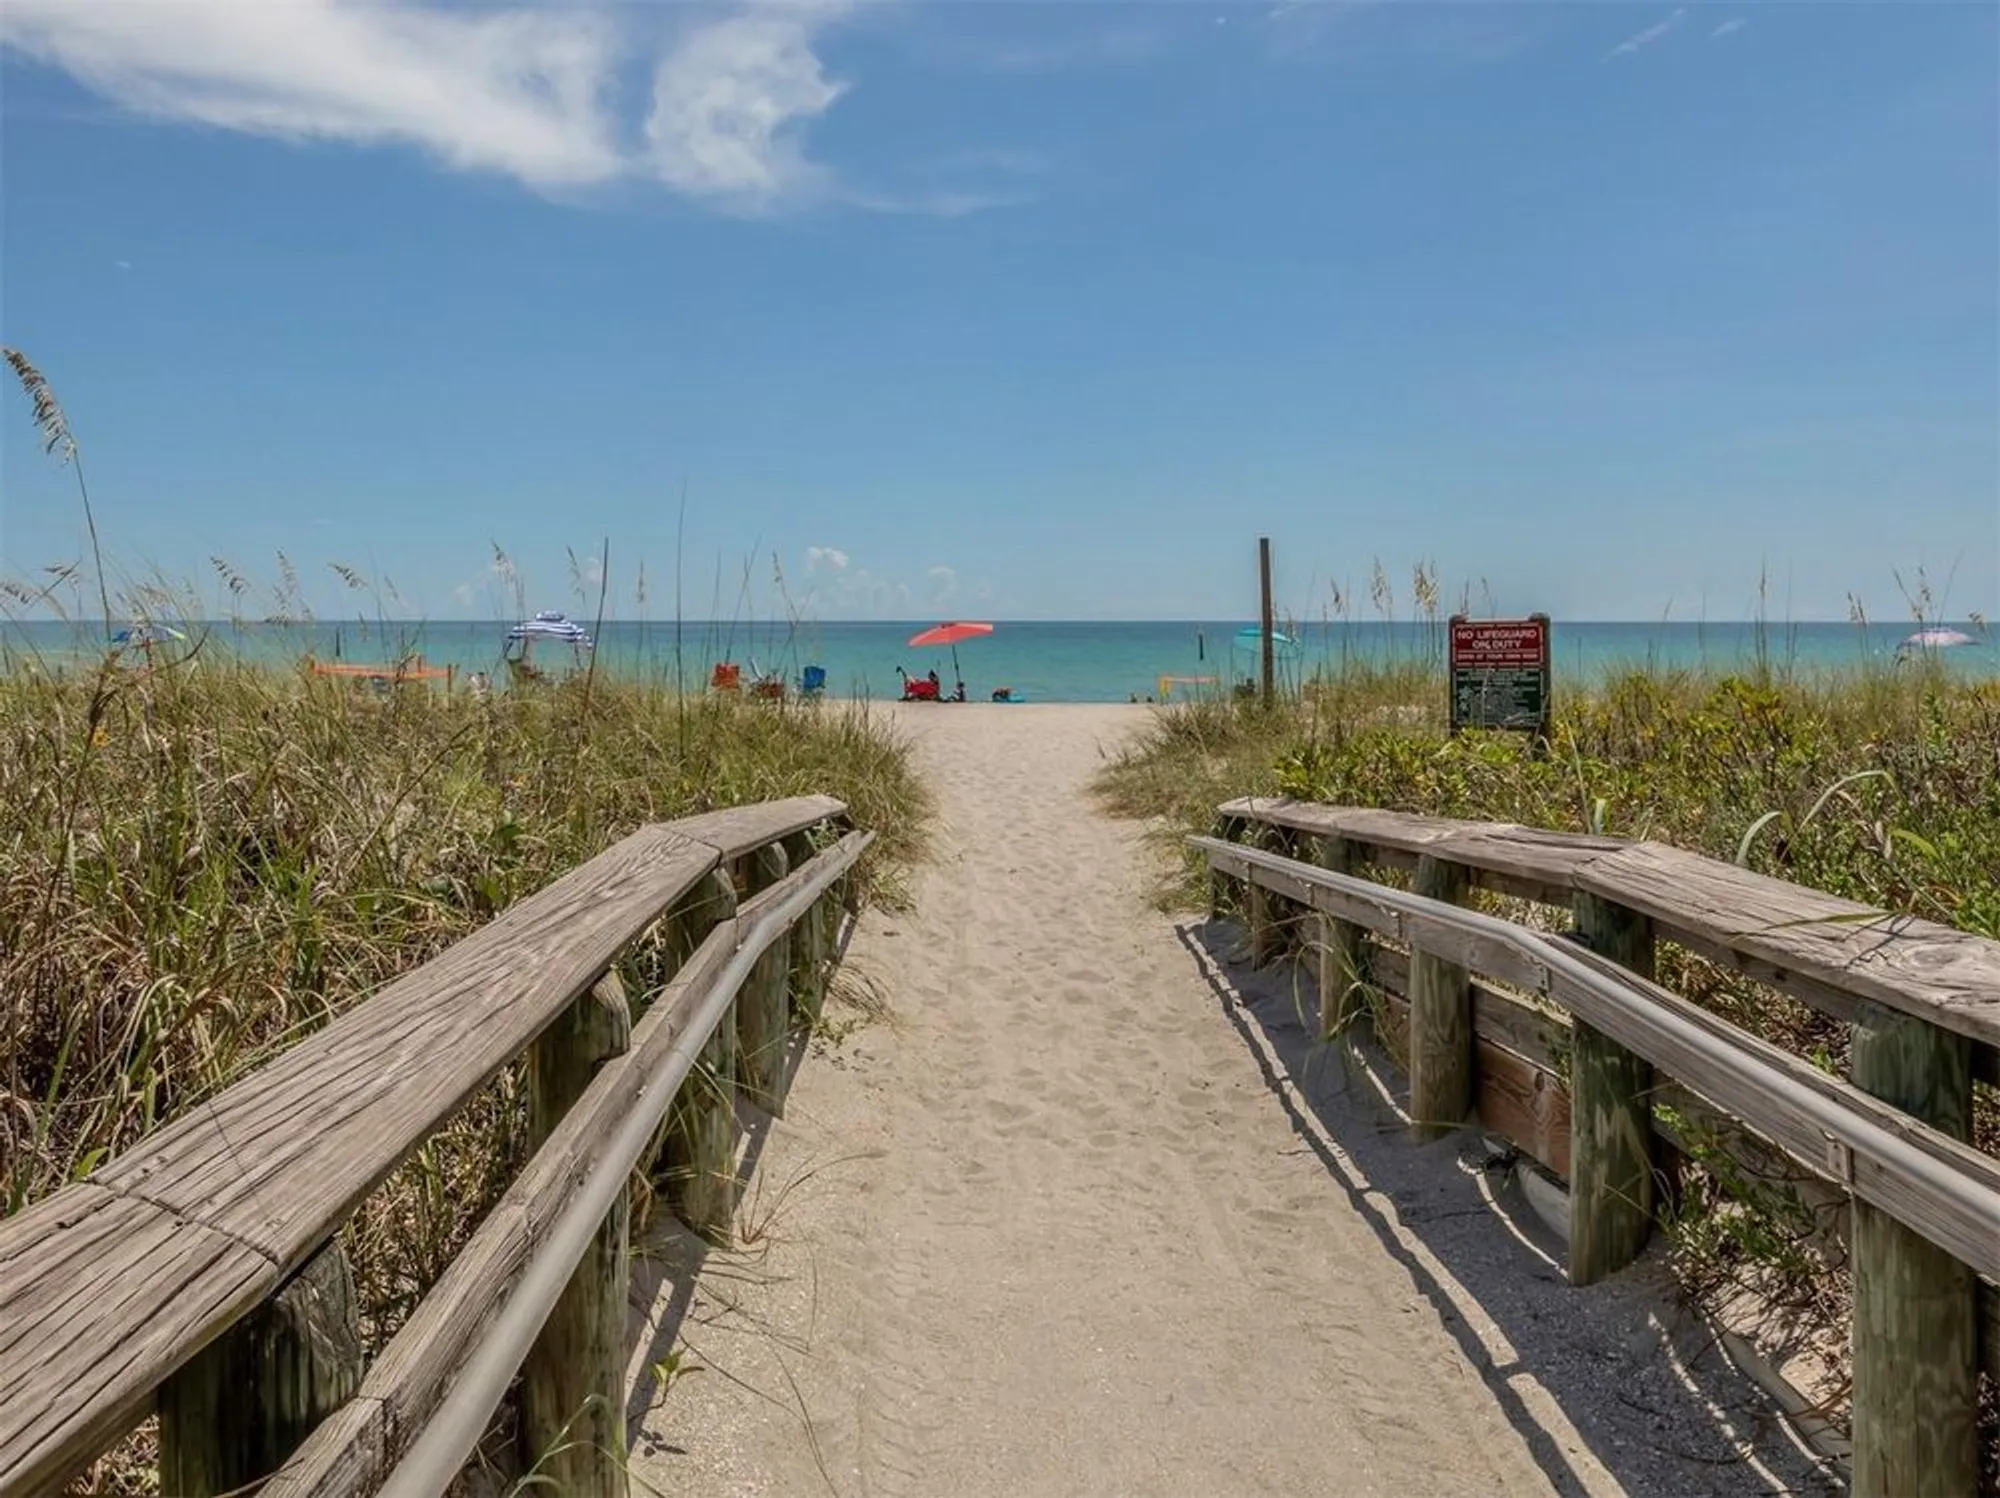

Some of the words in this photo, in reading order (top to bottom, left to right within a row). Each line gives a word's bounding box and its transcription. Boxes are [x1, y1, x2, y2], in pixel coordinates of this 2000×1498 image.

[1457, 630, 1474, 639] NO
[1477, 629, 1537, 639] LIFEGUARD
[1492, 640, 1522, 649] DUTY
